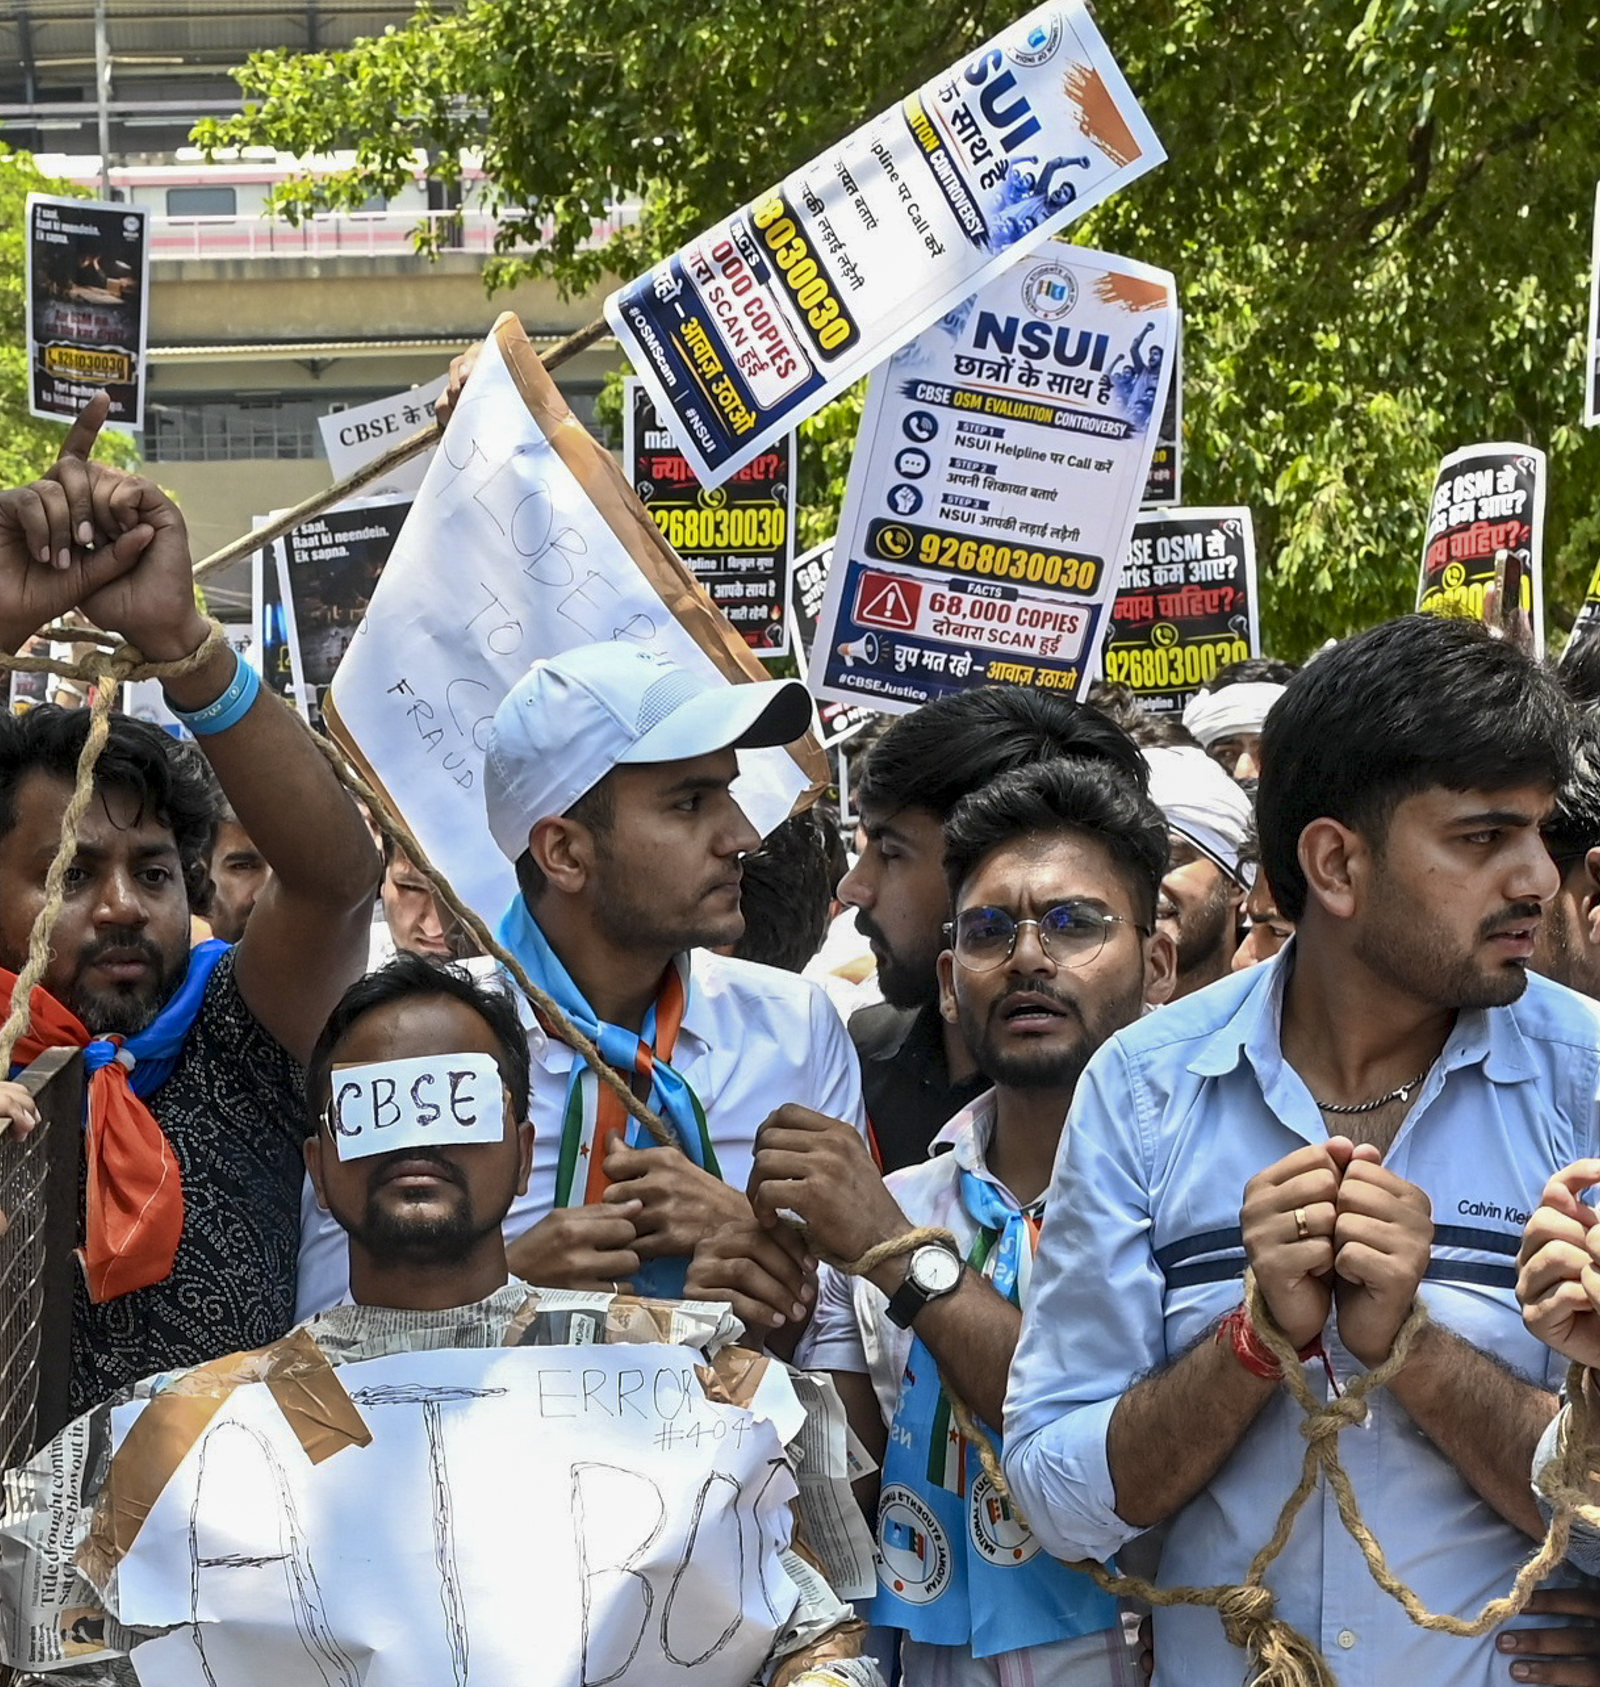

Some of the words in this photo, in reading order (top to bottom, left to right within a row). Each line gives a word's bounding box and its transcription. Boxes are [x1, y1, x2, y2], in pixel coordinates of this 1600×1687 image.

[963, 47, 1042, 154] SUI
[948, 106, 994, 165] साथ
[929, 149, 985, 240] CONTROVERSY
[743, 297, 797, 379] COPIES
[973, 311, 1110, 372] NSUI
[628, 306, 678, 388] #OSMScam
[685, 407, 717, 453] #NSUI
[954, 354, 1016, 384] छात्रों
[1018, 360, 1043, 389] के
[1047, 371, 1093, 399] साथ
[1097, 374, 1114, 405] है
[340, 413, 399, 447] CBSE
[402, 405, 421, 425] के
[711, 375, 758, 436] उठाओ
[916, 383, 951, 404] CBSE
[953, 391, 982, 410] OSM
[985, 397, 1054, 423] EVALUATION
[1054, 410, 1127, 437] CONTROVERSY
[954, 434, 991, 451] NSUI
[994, 443, 1047, 462] Helpline
[1067, 456, 1092, 470] Call
[652, 508, 785, 547] 268030030
[1156, 532, 1202, 564] OSM
[1205, 529, 1226, 557] से
[919, 533, 1096, 590] 9268030030
[1153, 563, 1185, 586] कम
[1188, 555, 1239, 582] आए?
[929, 592, 1011, 624] 68,000
[1016, 607, 1079, 634] COPIES
[967, 583, 1002, 598] FACTS
[1158, 585, 1236, 619] चाहिए?
[932, 616, 984, 641] दोबारा
[987, 629, 1036, 650] SCAN
[838, 673, 927, 701] #CBSEJustice
[894, 644, 918, 671] चुप
[921, 650, 948, 672] मत
[950, 652, 972, 677] रहो
[1035, 666, 1078, 692] उठाओ
[387, 677, 474, 790] FRAUD
[335, 1069, 478, 1138] CBSE
[1458, 1199, 1502, 1219] Calvin
[653, 1417, 752, 1451] #404
